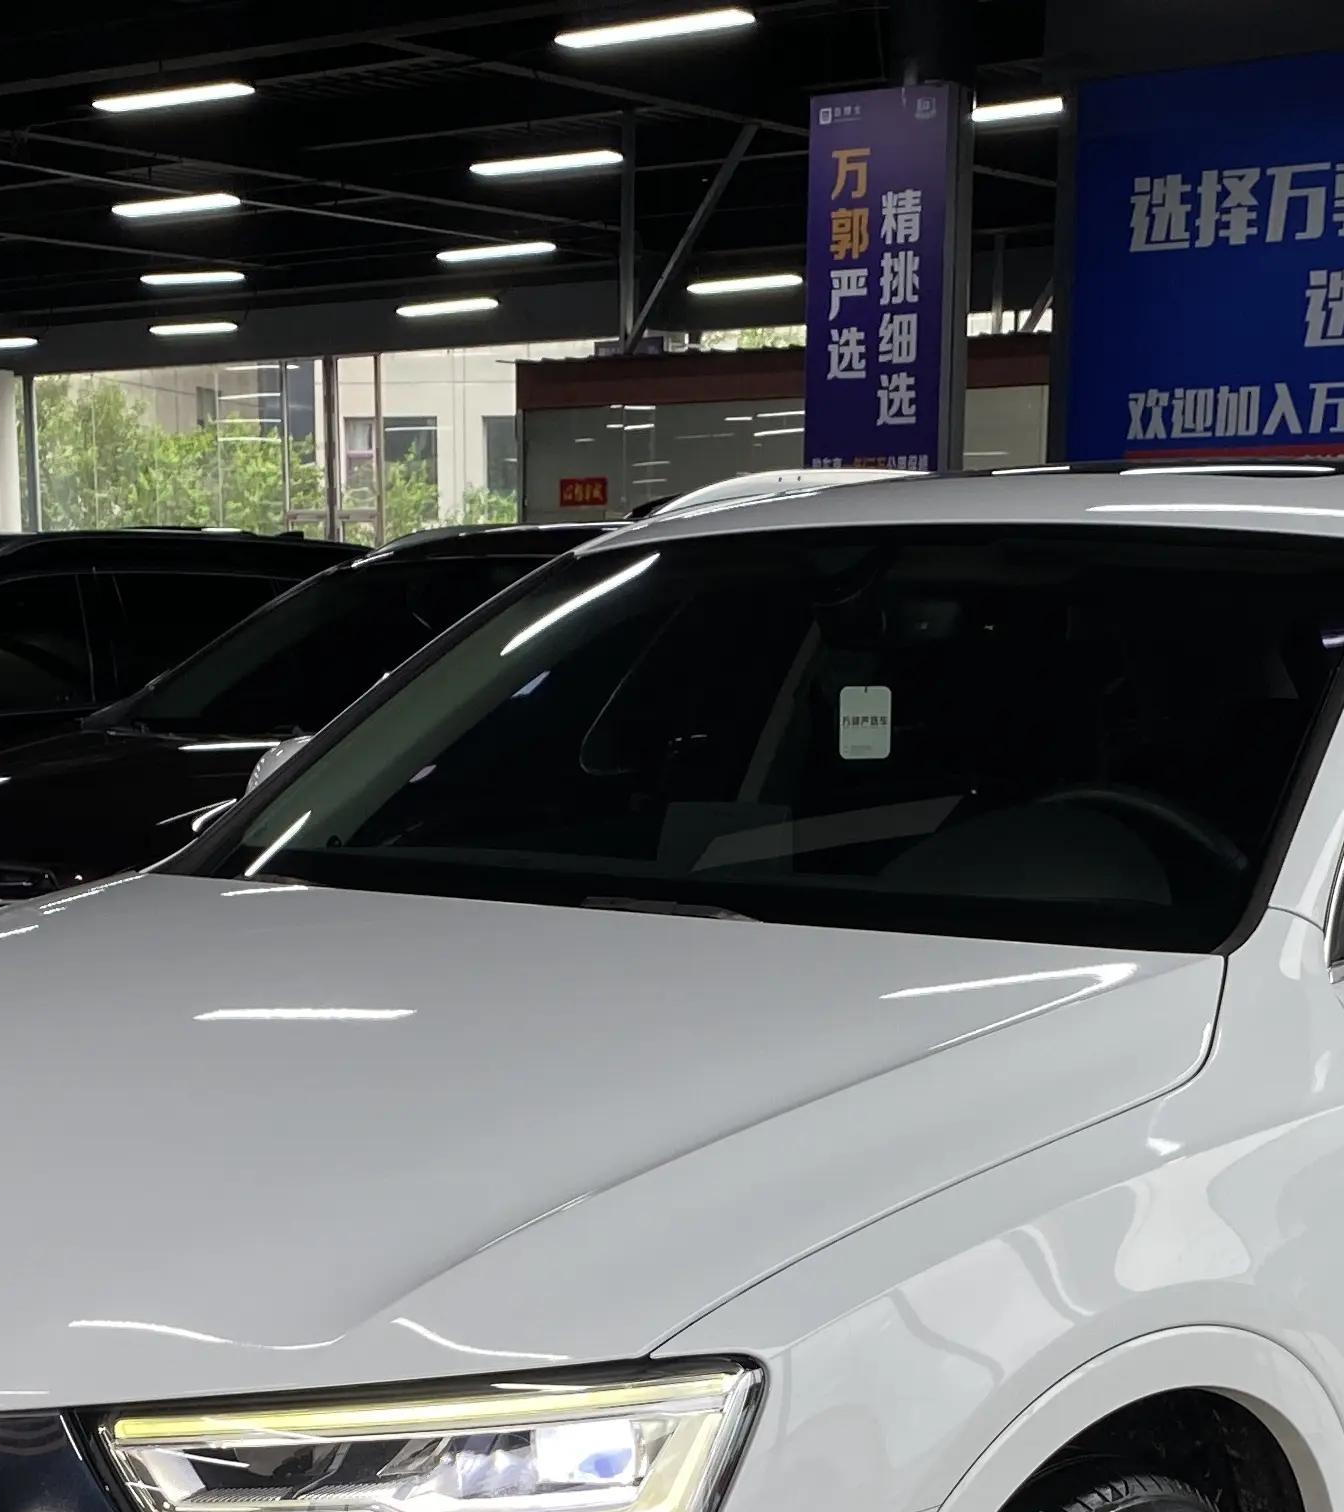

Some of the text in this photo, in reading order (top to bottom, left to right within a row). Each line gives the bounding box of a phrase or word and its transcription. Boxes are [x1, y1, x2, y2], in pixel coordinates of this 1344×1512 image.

[827, 147, 871, 381] 万郭严选
[876, 188, 922, 426] 精挑细选
